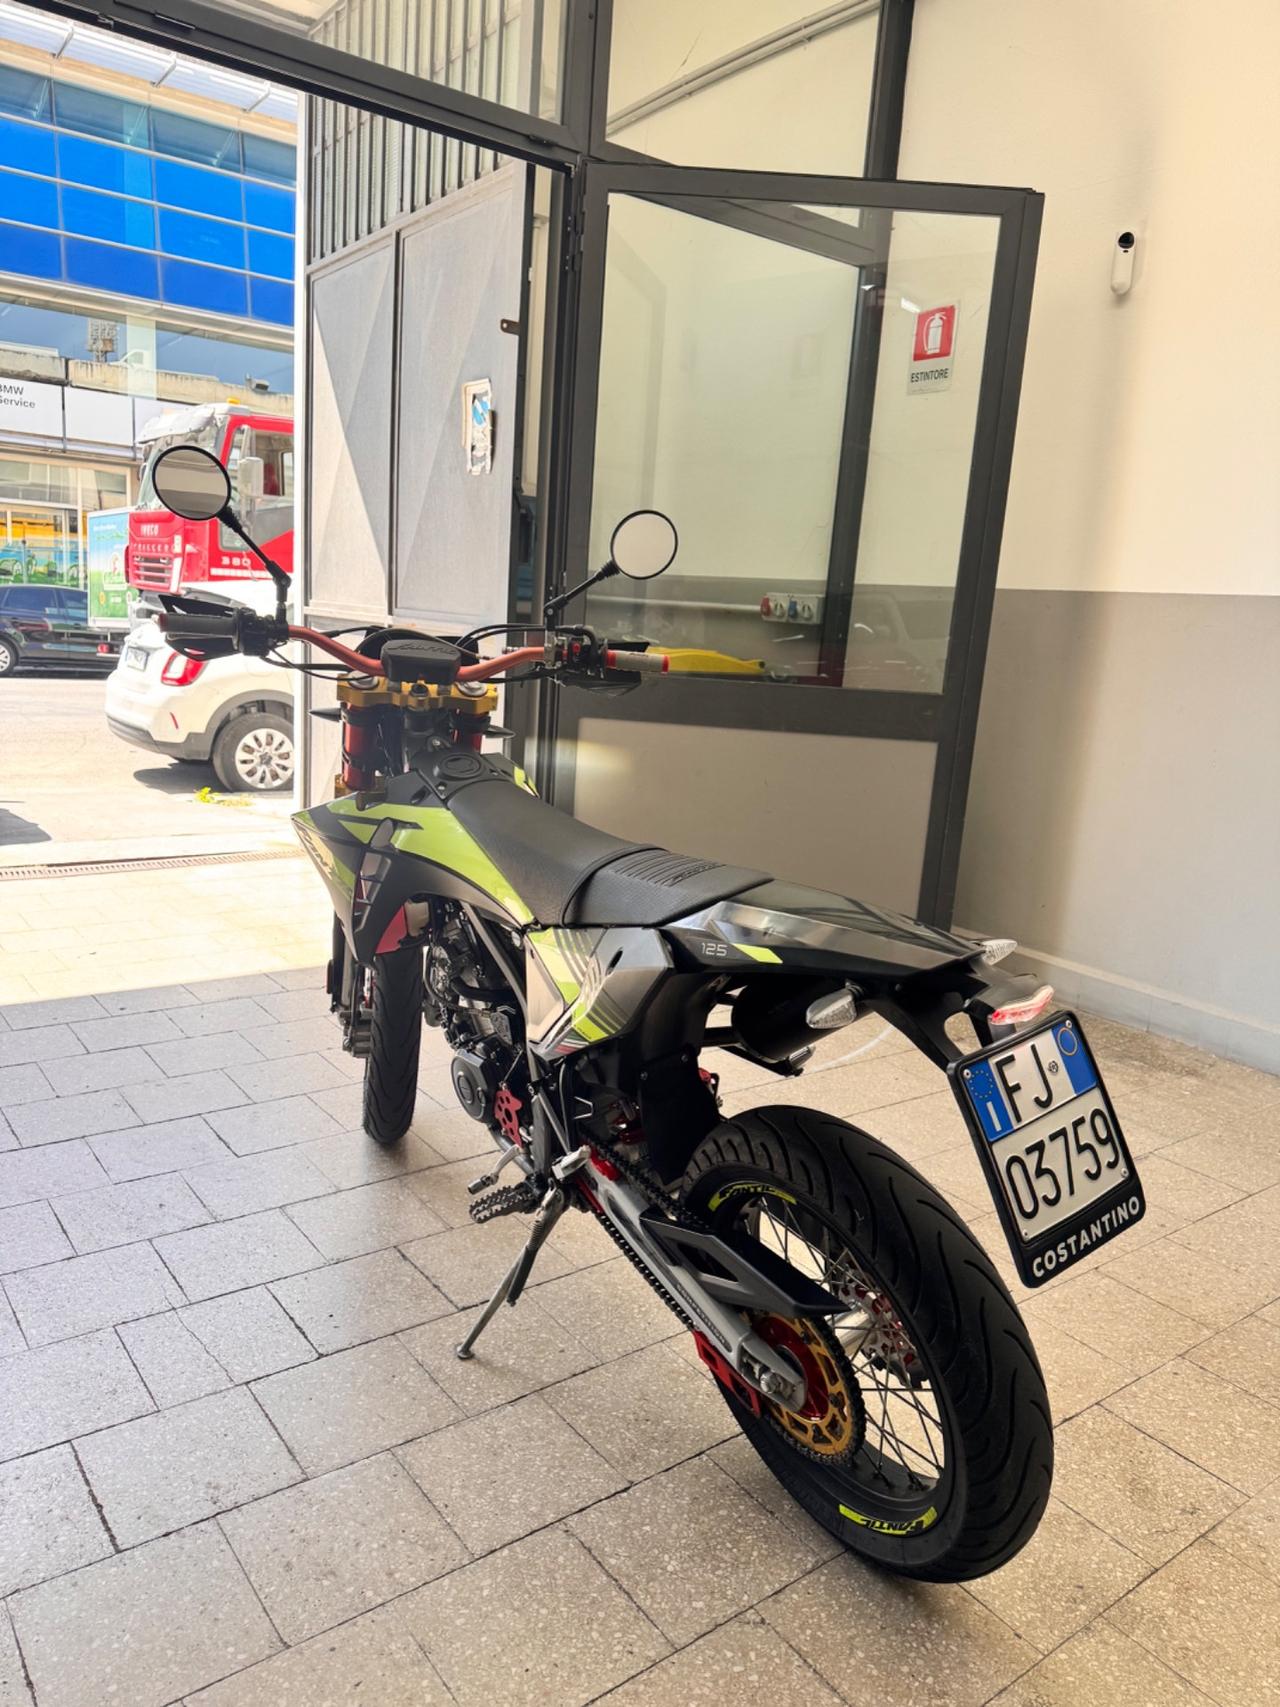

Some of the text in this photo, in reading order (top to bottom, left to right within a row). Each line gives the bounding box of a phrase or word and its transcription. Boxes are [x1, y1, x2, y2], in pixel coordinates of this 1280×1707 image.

[911, 368, 949, 383] ESTINTORE
[701, 942, 728, 957] 125
[995, 1044, 1053, 1124] FJ
[1005, 1108, 1121, 1220] 03759
[1032, 1196, 1140, 1278] COSTANTINO
